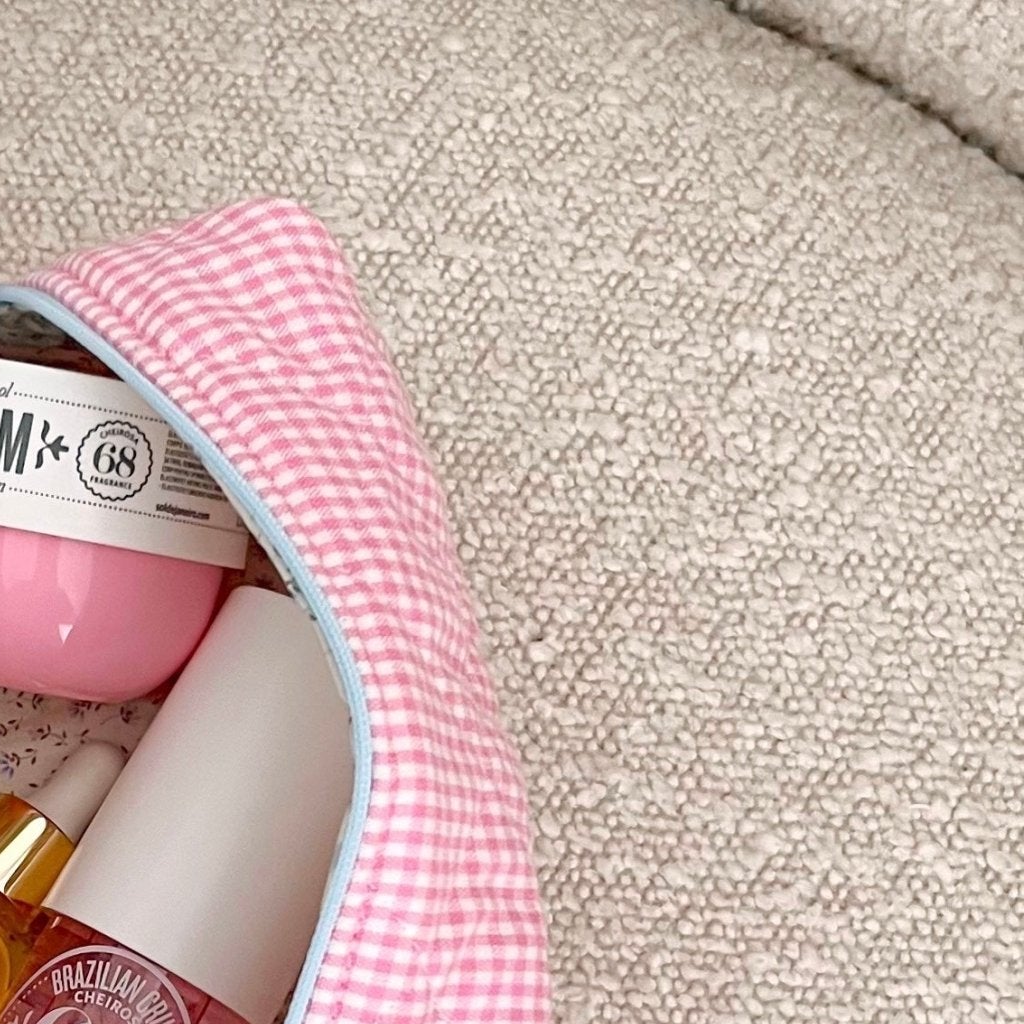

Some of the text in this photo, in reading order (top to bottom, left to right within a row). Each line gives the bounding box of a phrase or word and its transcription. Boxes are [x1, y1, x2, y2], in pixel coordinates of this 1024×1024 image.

[93, 442, 137, 478] 68
[90, 475, 132, 490] FRAGRANCE
[51, 960, 147, 1003] BRAZILIAN
